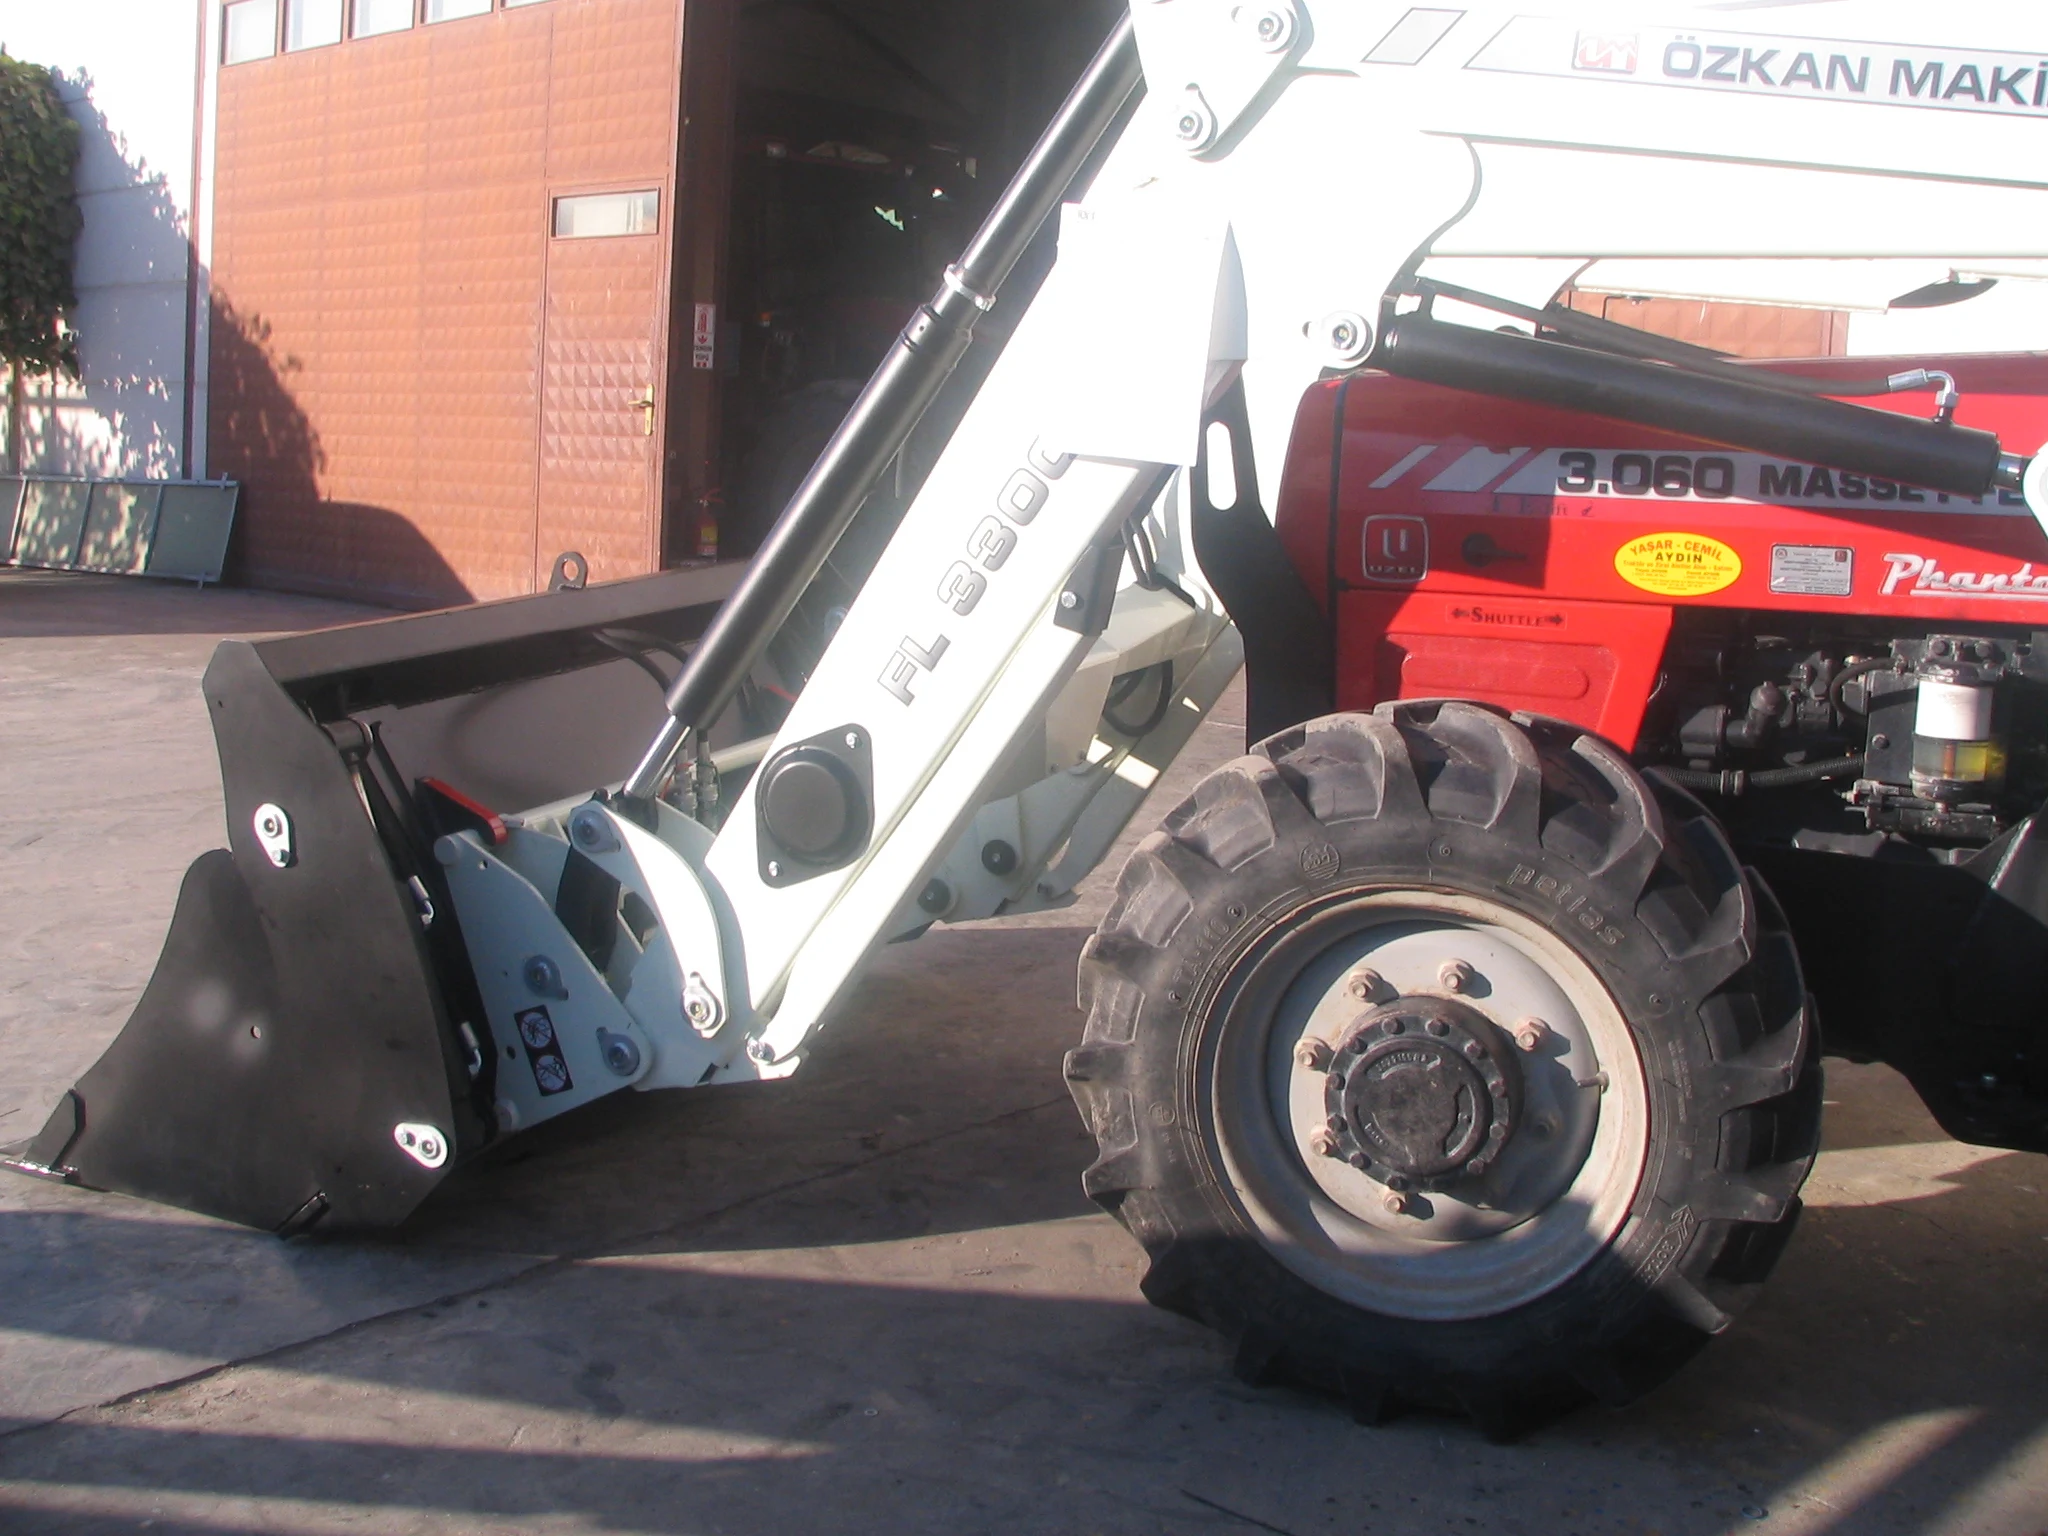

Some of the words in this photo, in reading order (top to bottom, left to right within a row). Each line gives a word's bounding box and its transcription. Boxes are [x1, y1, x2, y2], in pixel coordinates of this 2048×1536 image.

[1662, 34, 1870, 94] ÖZKAN
[1557, 450, 1735, 500] 3.060
[1629, 539, 1673, 556] YAŞAR
[1684, 540, 1723, 561] CEMİL
[1655, 552, 1703, 563] AYDIN
[876, 633, 951, 707] FL
[1506, 863, 1625, 945] petlas
